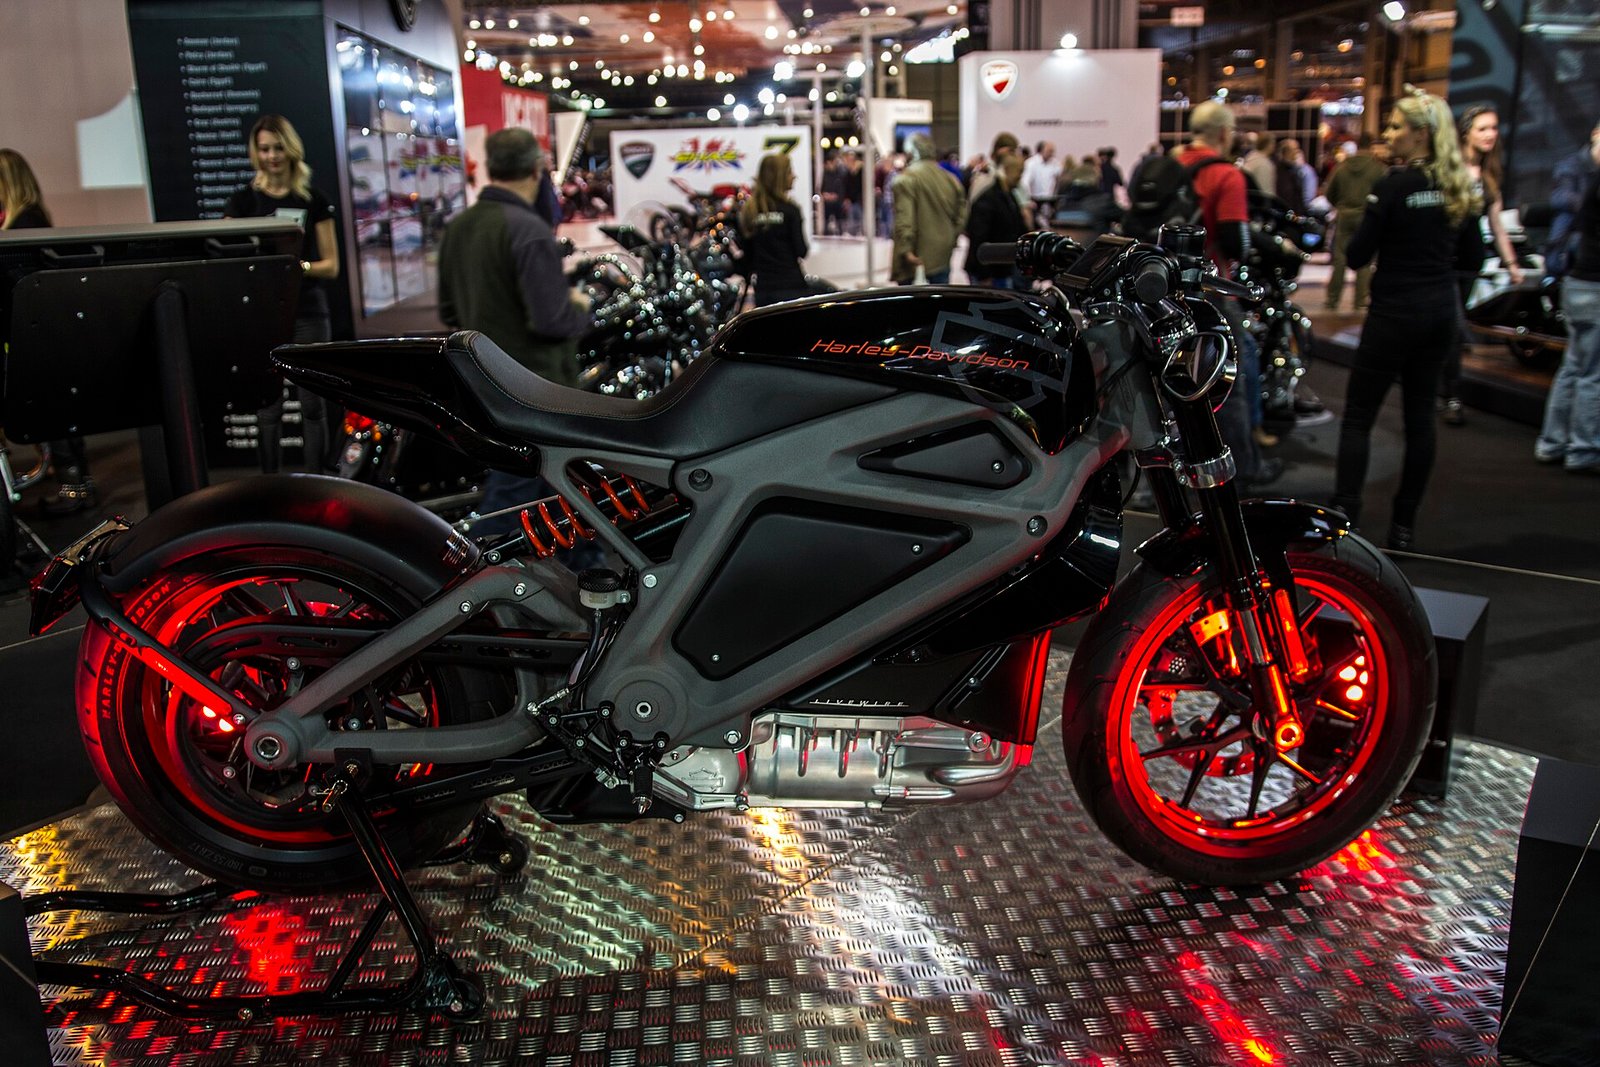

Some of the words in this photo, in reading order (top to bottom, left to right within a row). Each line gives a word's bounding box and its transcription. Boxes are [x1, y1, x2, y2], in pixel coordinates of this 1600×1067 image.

[810, 339, 1030, 370] Harley-Davidson
[102, 582, 170, 719] HARLEY-DIDSON
[810, 699, 908, 707] LIVEWIRE
